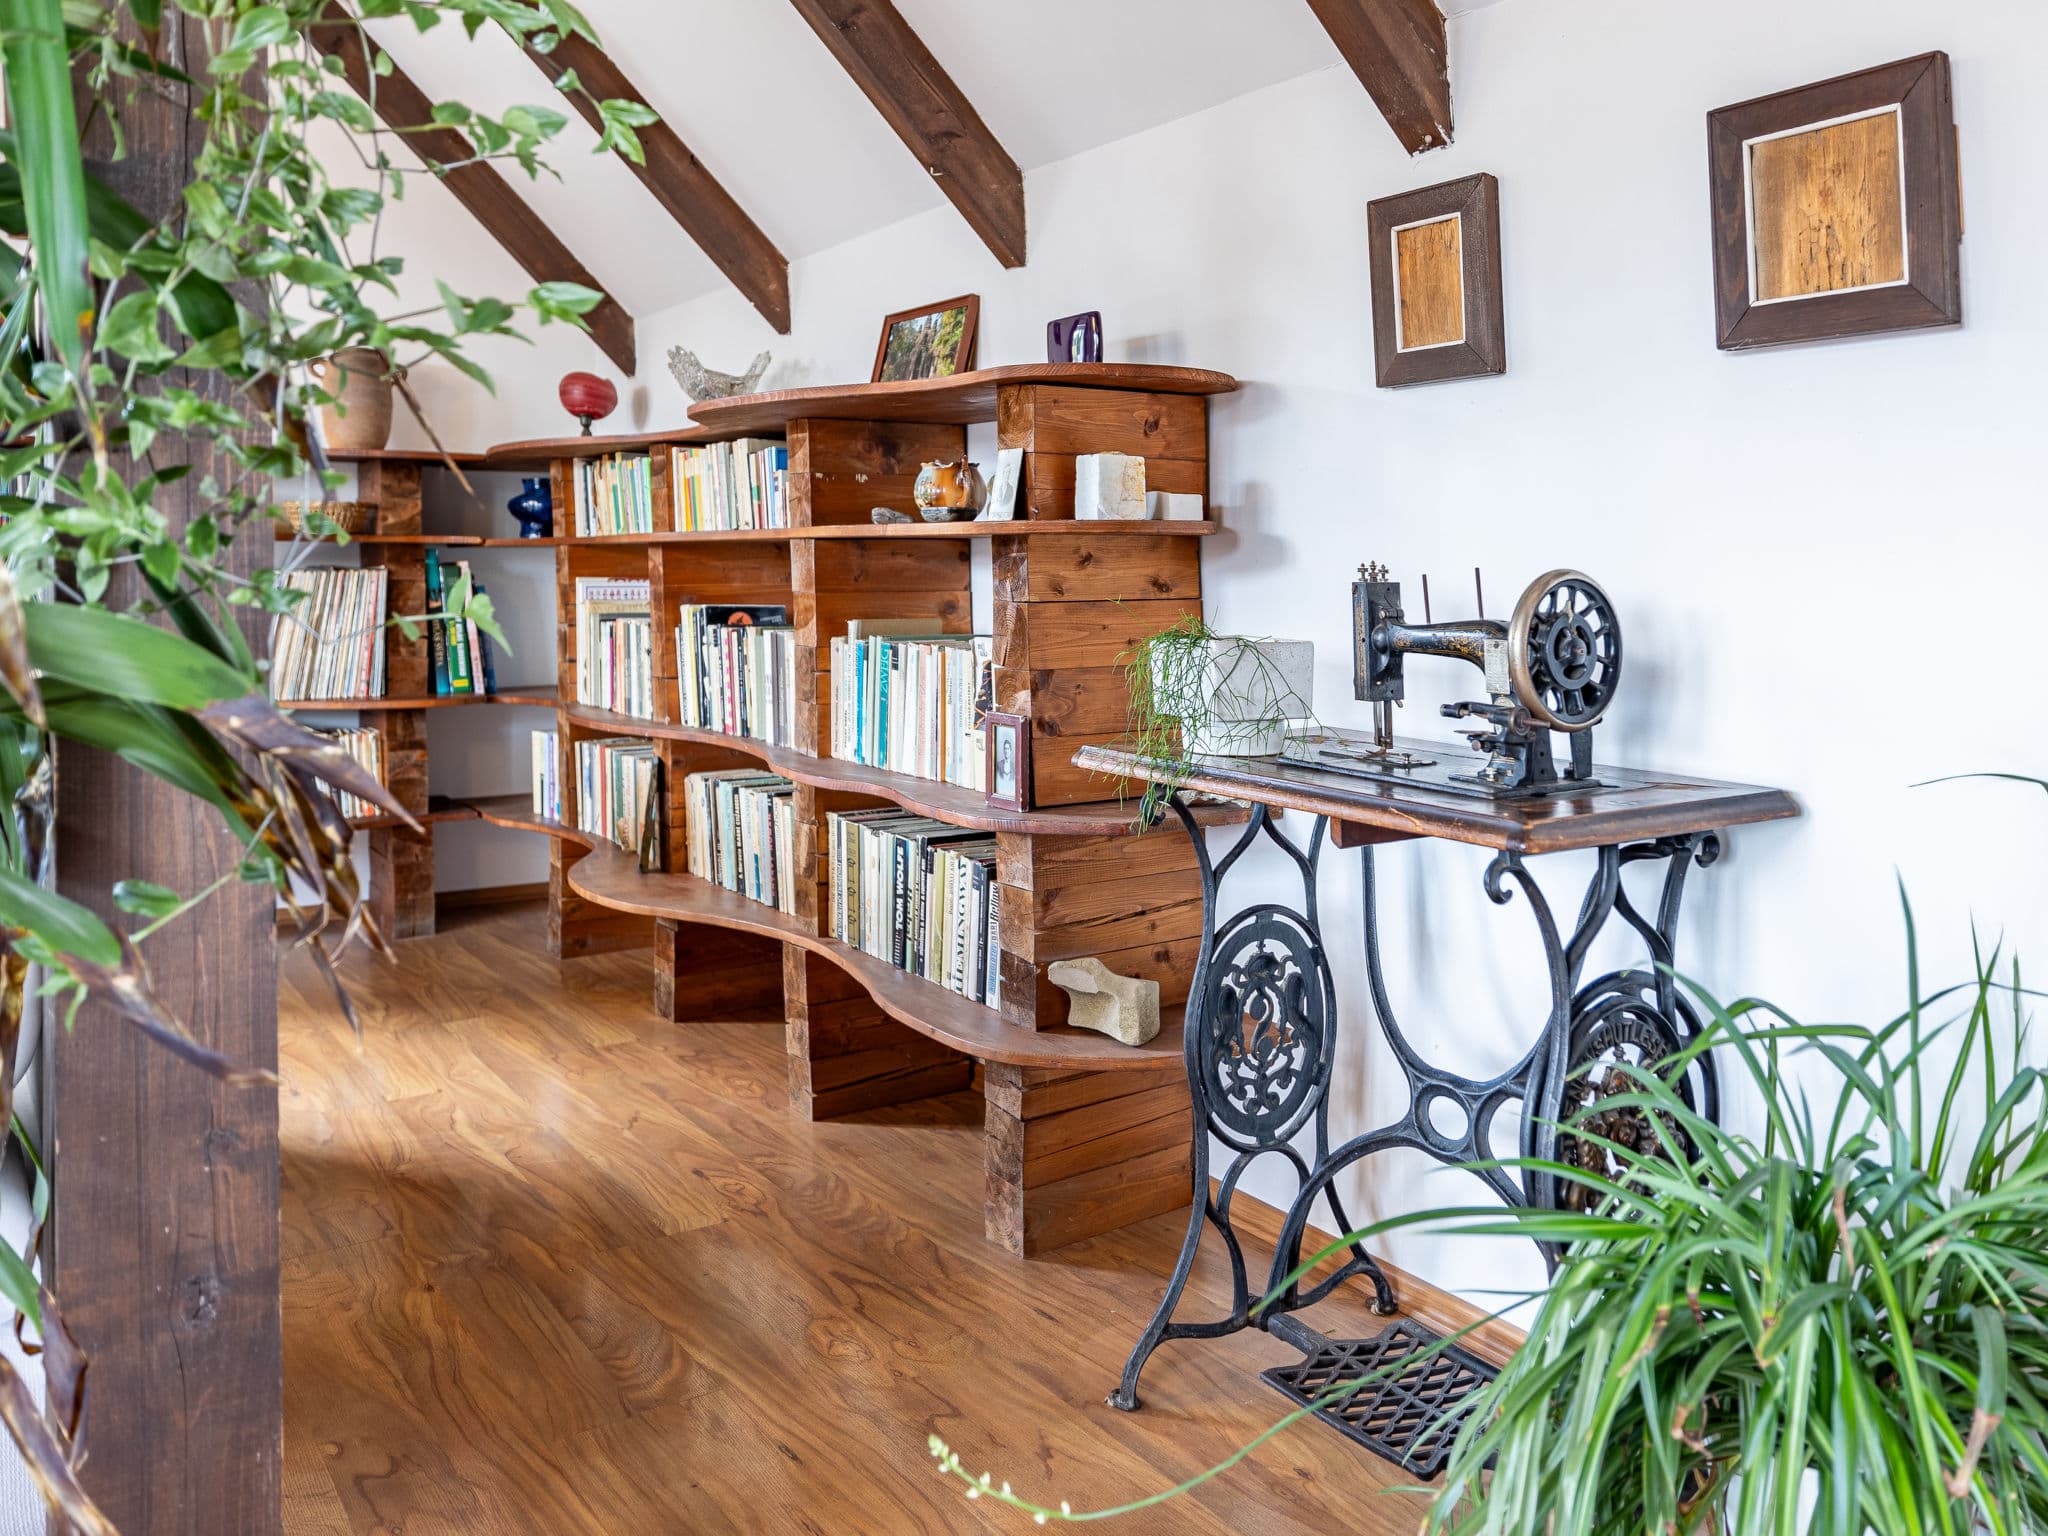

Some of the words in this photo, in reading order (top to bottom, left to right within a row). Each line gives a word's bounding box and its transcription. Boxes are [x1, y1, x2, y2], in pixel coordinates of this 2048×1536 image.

[880, 648, 889, 693] ZWEIG
[896, 846, 904, 895] WOLFE
[895, 898, 904, 930] TOM
[989, 884, 999, 922] Bellow
[955, 863, 967, 992] HEMINGWAY
